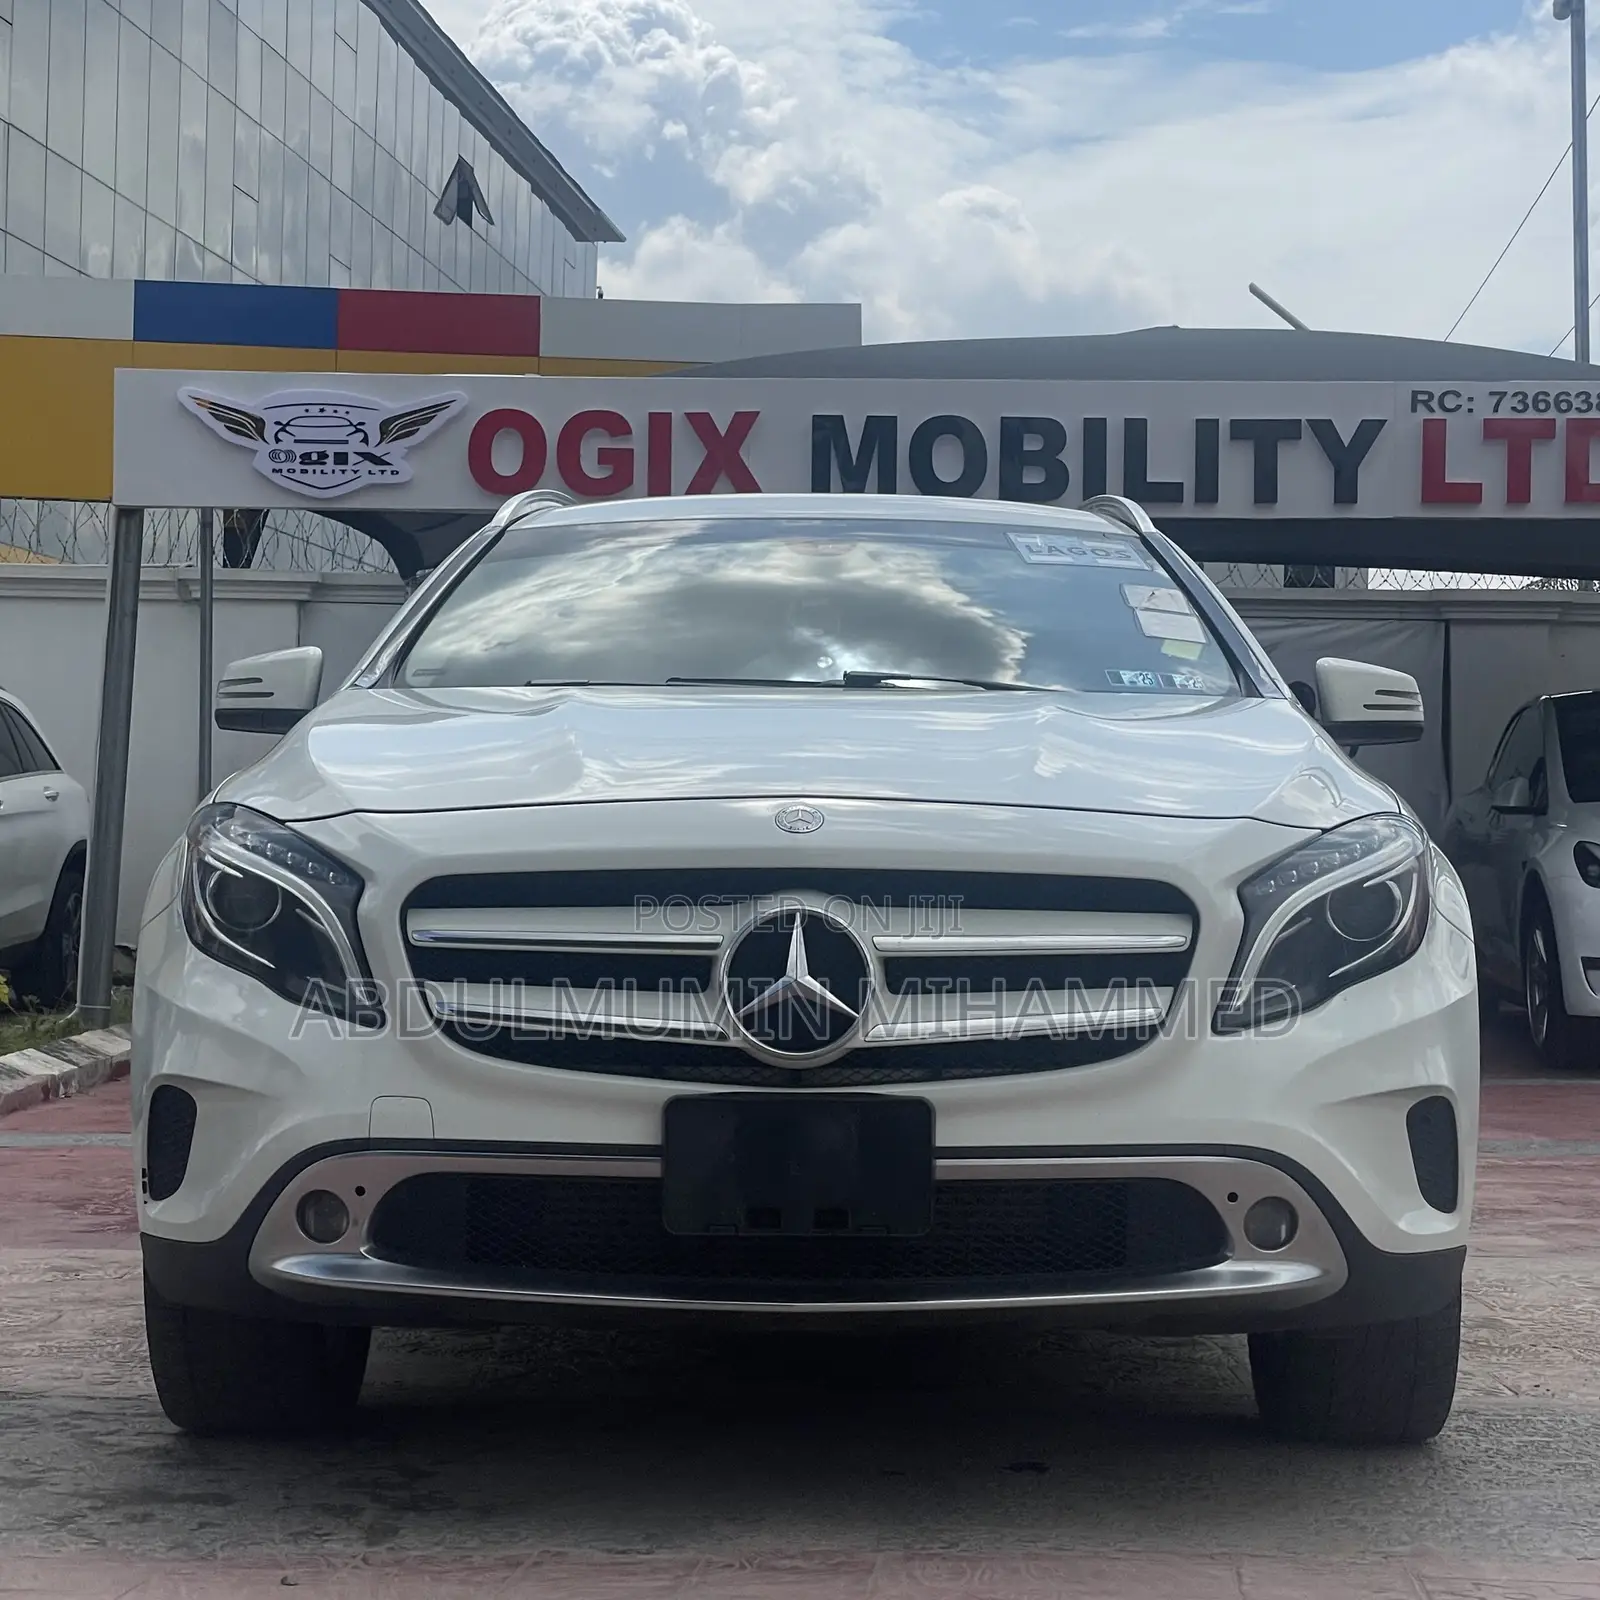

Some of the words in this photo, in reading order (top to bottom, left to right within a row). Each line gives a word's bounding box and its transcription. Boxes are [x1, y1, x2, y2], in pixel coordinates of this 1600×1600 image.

[1410, 390, 1474, 413] RC:
[1488, 390, 1600, 414] 73663
[468, 408, 762, 497] OGIX
[811, 414, 1388, 504] MOBILITY
[1025, 544, 1131, 560] LAGOS
